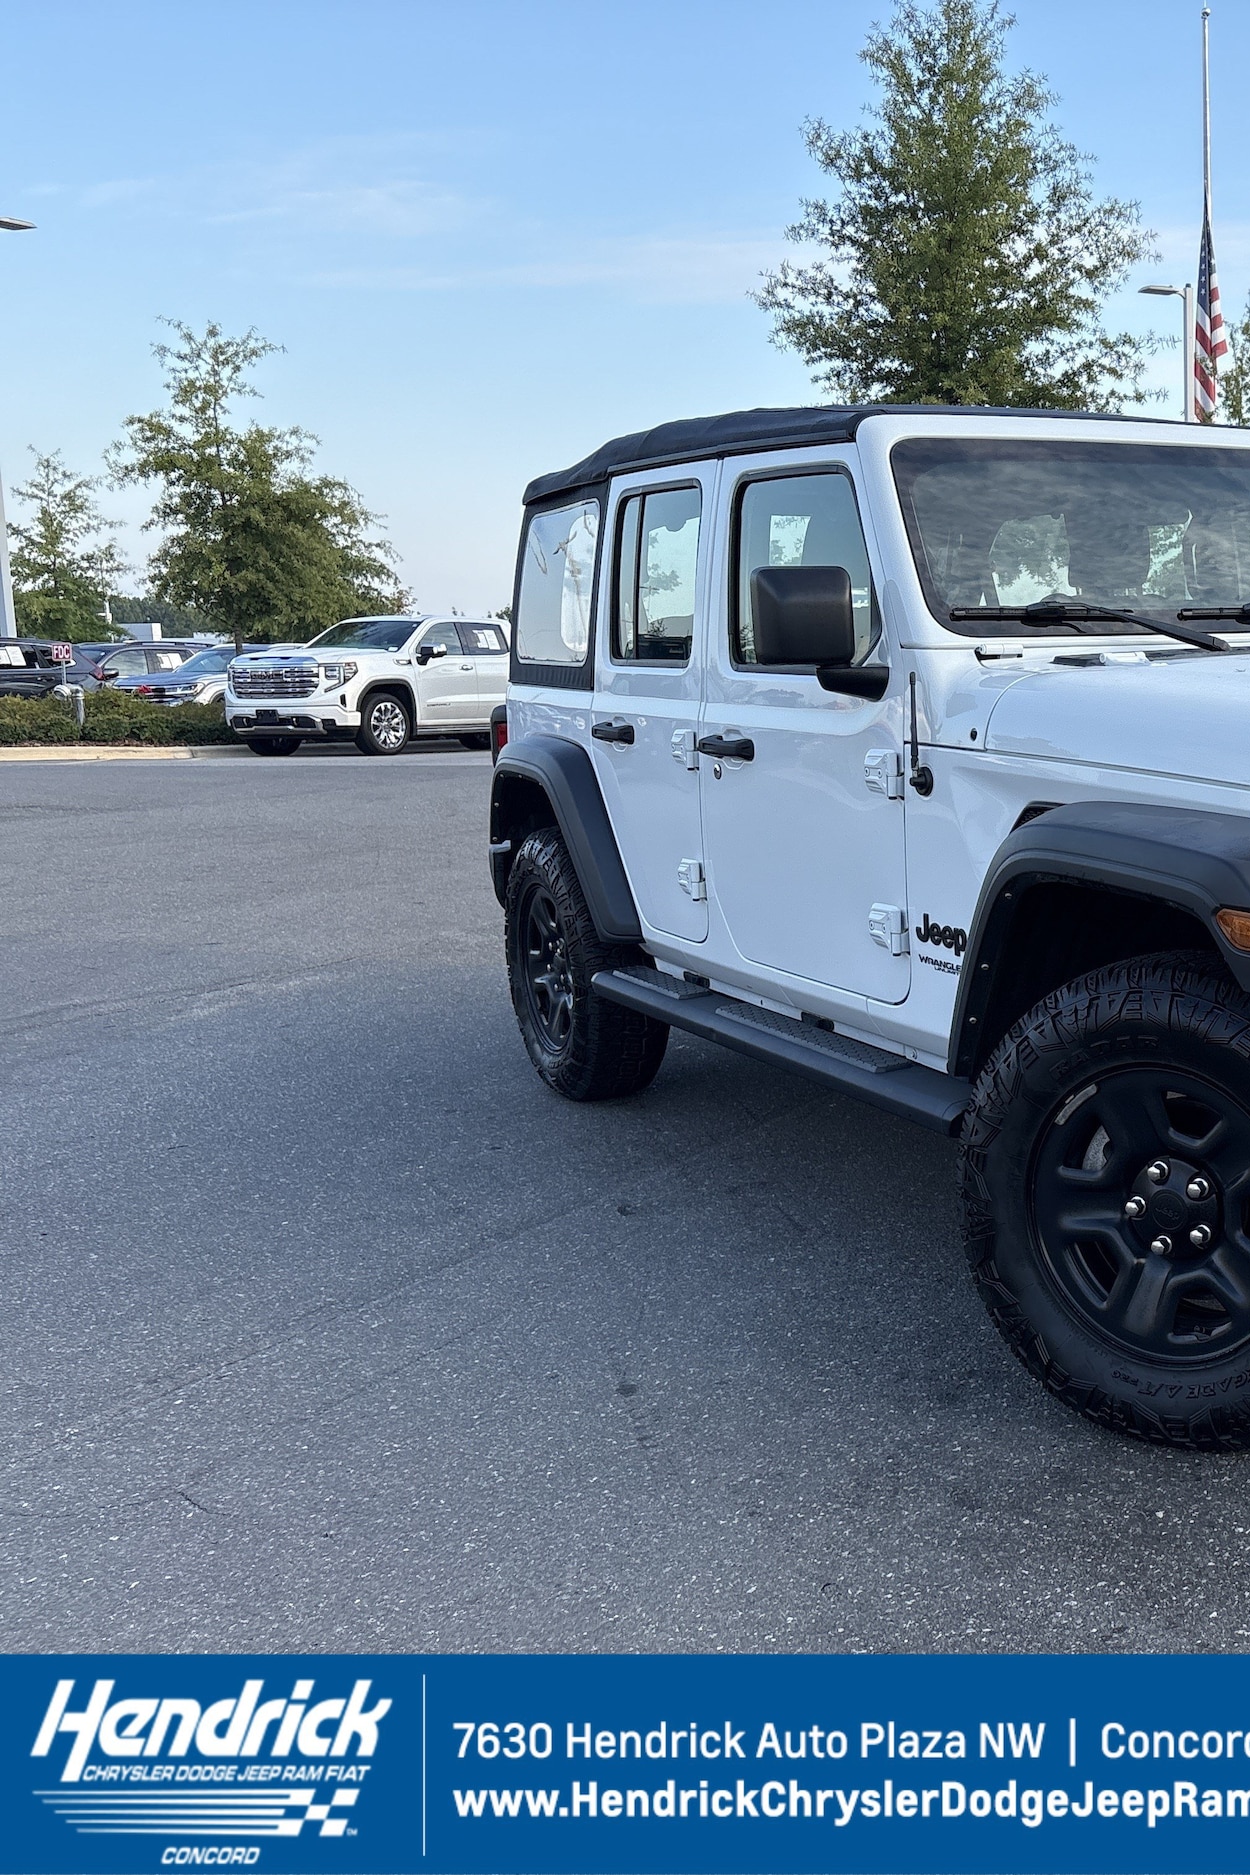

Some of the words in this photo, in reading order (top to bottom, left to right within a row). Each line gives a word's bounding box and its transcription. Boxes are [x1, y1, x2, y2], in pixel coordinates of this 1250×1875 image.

[53, 645, 70, 659] FDC
[916, 913, 967, 957] Jeep
[918, 953, 962, 972] WRANGLE
[1138, 1380, 1182, 1399] A/T
